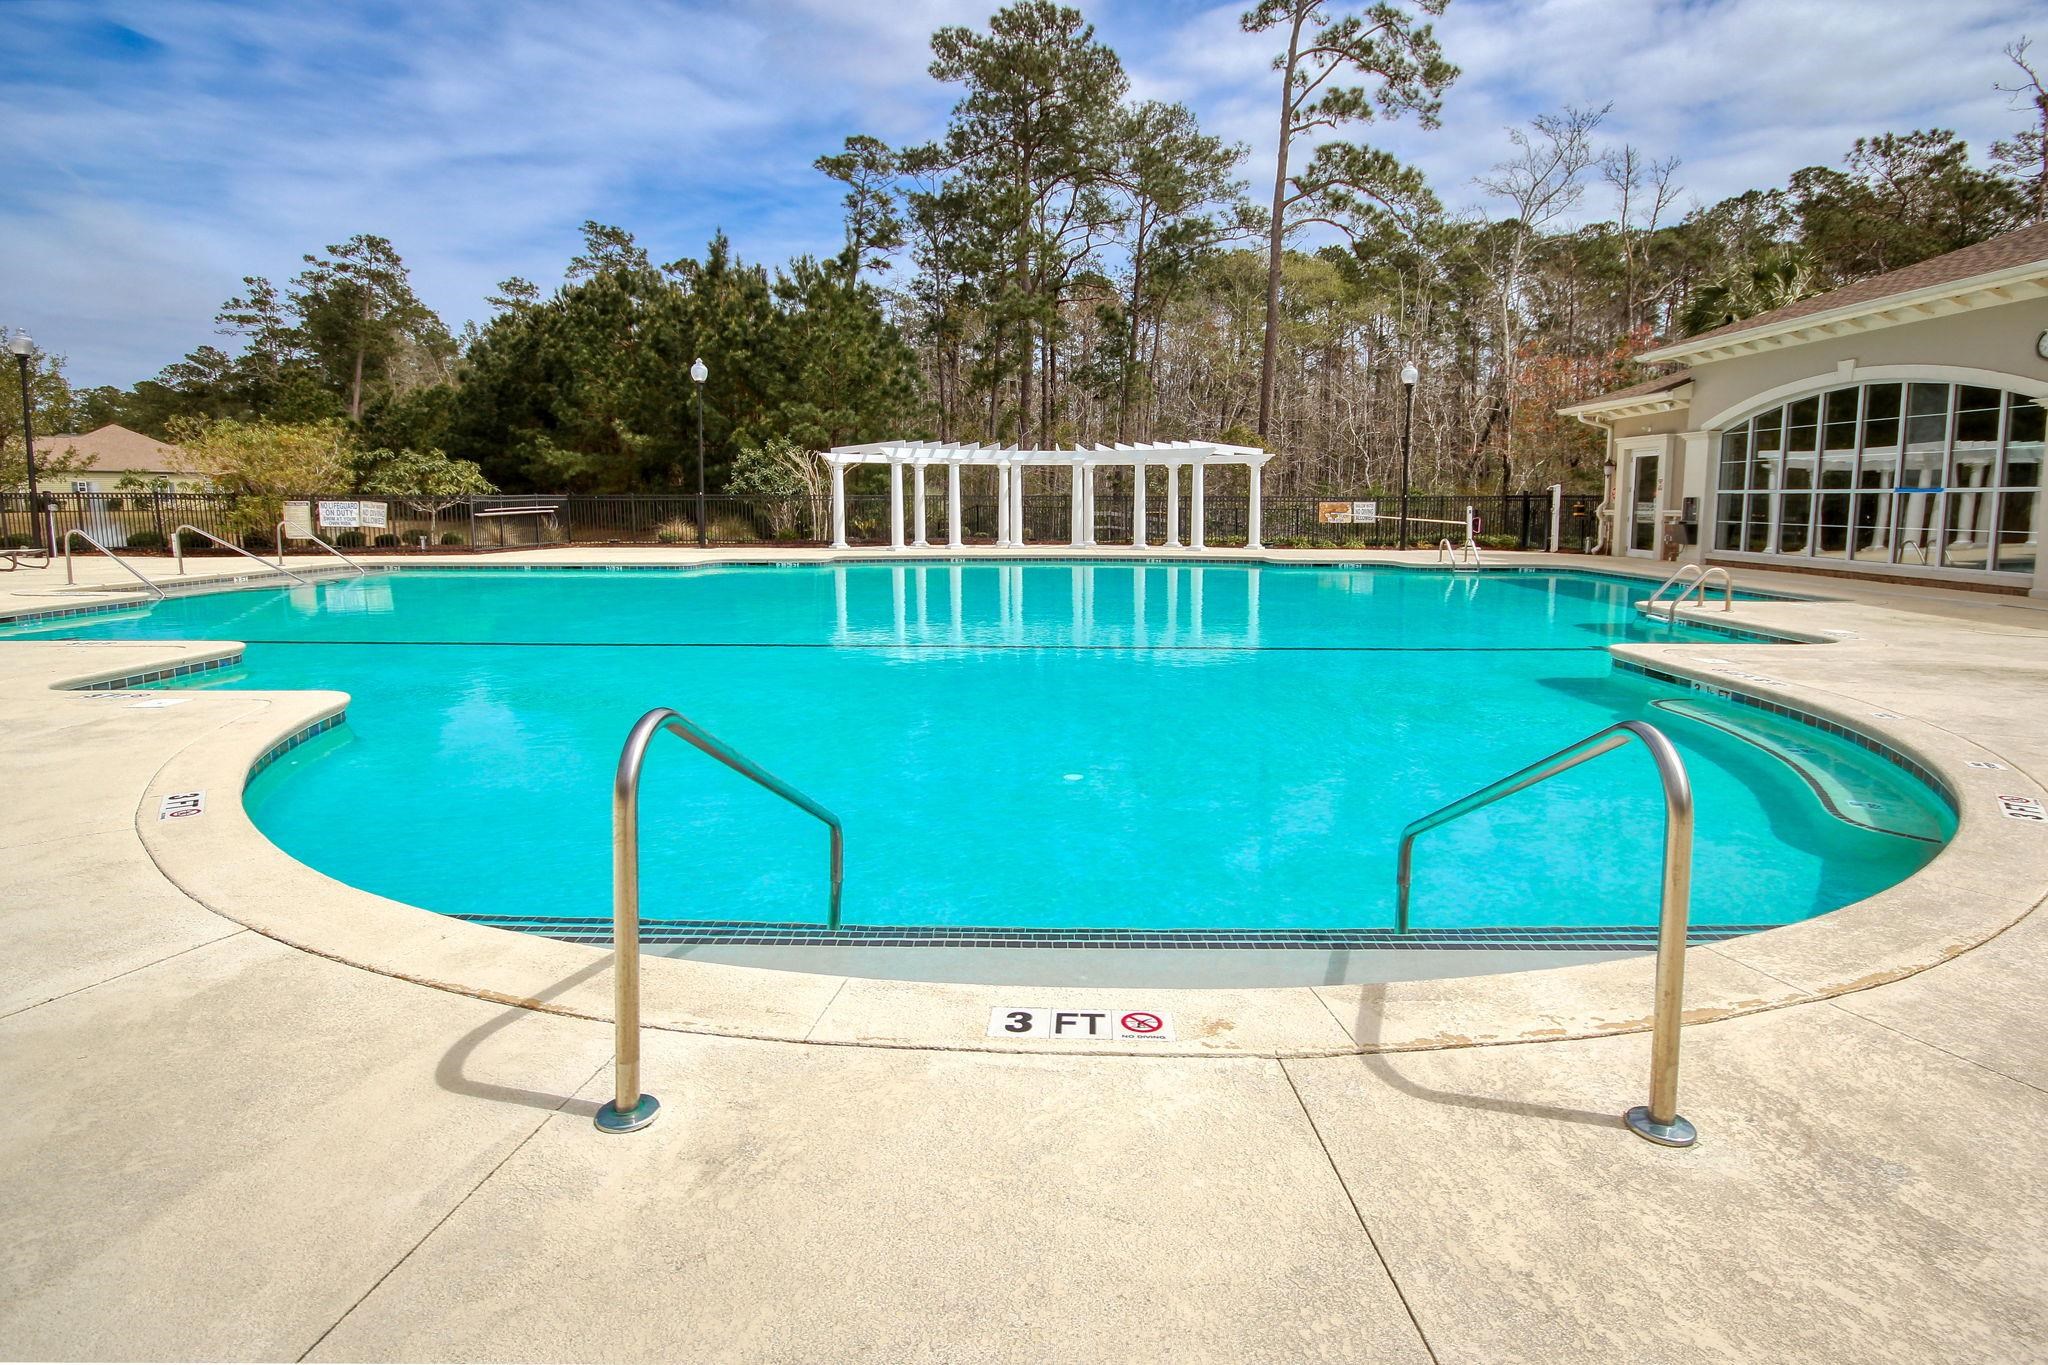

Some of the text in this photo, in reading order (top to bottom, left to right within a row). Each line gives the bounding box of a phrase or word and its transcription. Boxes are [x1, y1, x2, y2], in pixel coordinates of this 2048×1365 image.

[328, 502, 358, 510] LIFEGUARD
[1004, 1011, 1106, 1035] 3 FT
